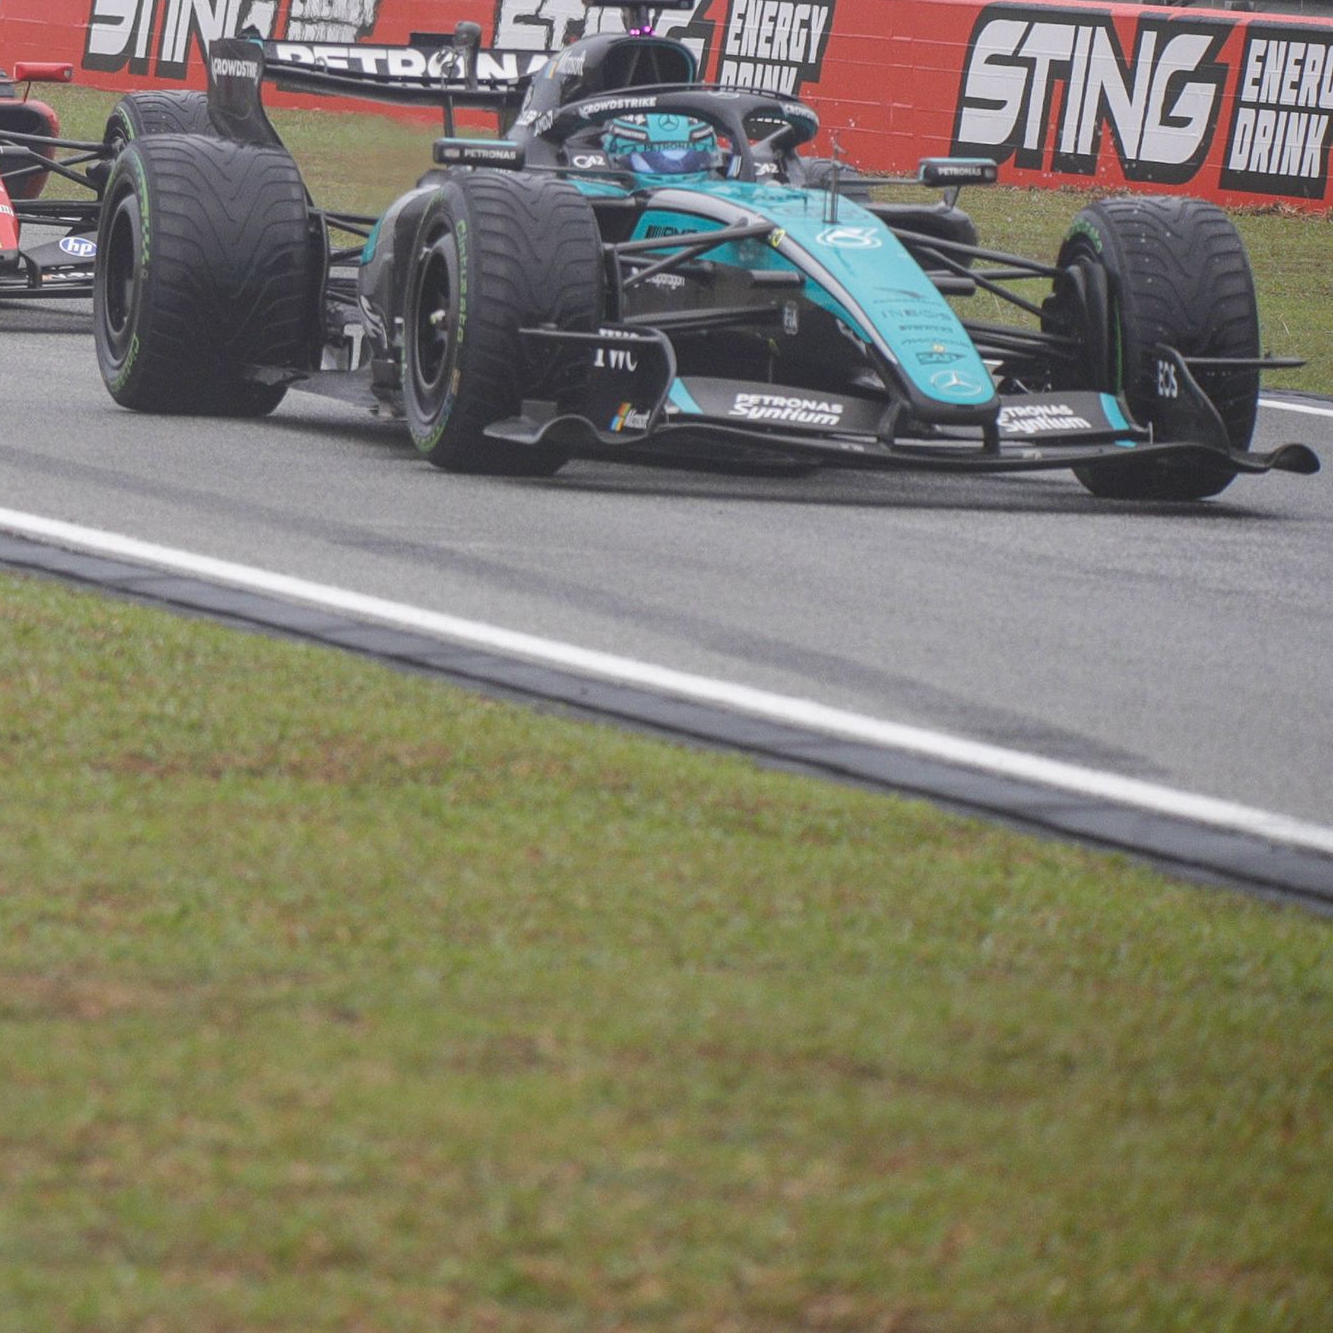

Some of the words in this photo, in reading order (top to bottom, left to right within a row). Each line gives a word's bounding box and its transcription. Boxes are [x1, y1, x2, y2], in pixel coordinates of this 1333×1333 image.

[958, 18, 1216, 166] STING
[582, 96, 657, 116] CROWDSTRIKE
[1228, 107, 1329, 178] DRINK
[464, 148, 517, 160] PETRONAS
[937, 166, 982, 176] PETRONAS
[65, 236, 94, 256] hp
[735, 393, 844, 414] PETRONAS
[728, 403, 841, 426] Syntium
